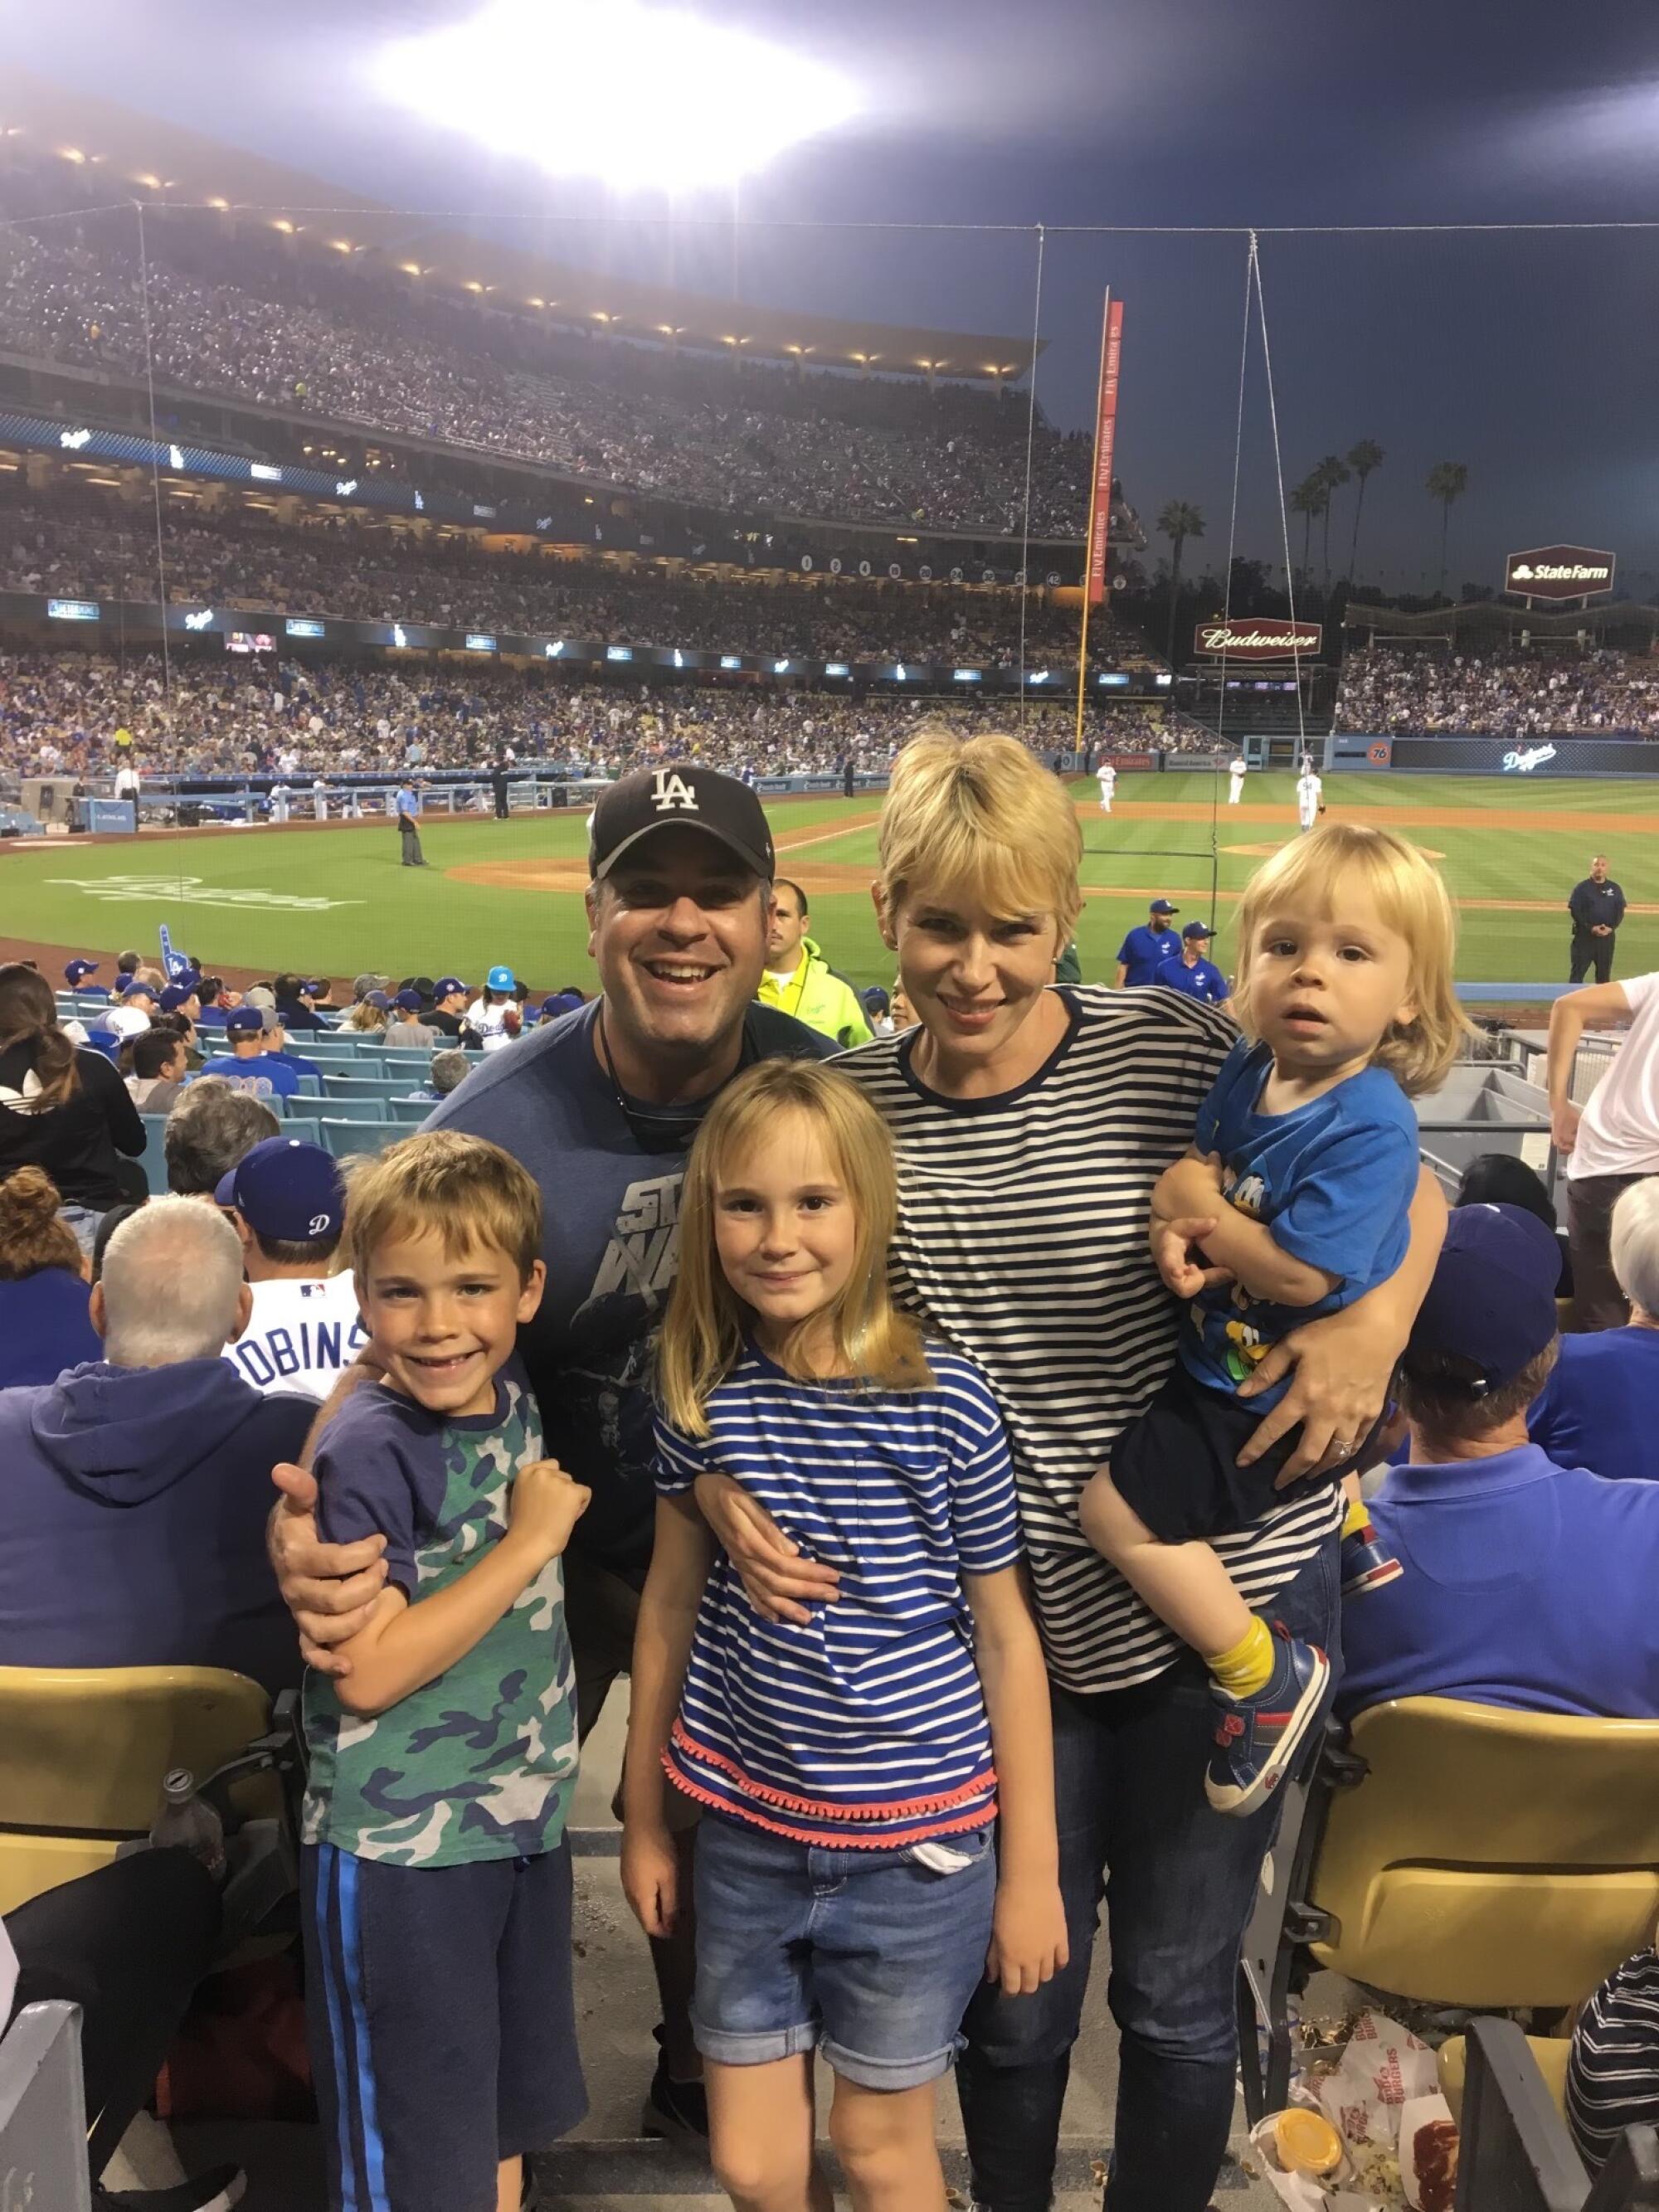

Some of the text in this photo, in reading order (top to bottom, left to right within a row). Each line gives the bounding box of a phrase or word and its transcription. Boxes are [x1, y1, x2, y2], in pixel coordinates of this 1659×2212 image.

[1105, 379, 1117, 395] Fly
[1097, 420, 1112, 488] Fly Emirates
[1092, 510, 1105, 579] Fly Emirates
[1048, 575, 1060, 585] 42
[1201, 628, 1317, 649] Budweiser
[1373, 748, 1387, 759] 76
[650, 768, 699, 811] LA
[168, 957, 183, 975] LA
[615, 1172, 684, 1235] ST
[309, 1213, 330, 1235] D
[1387, 2048, 1405, 2104] BURGERS
